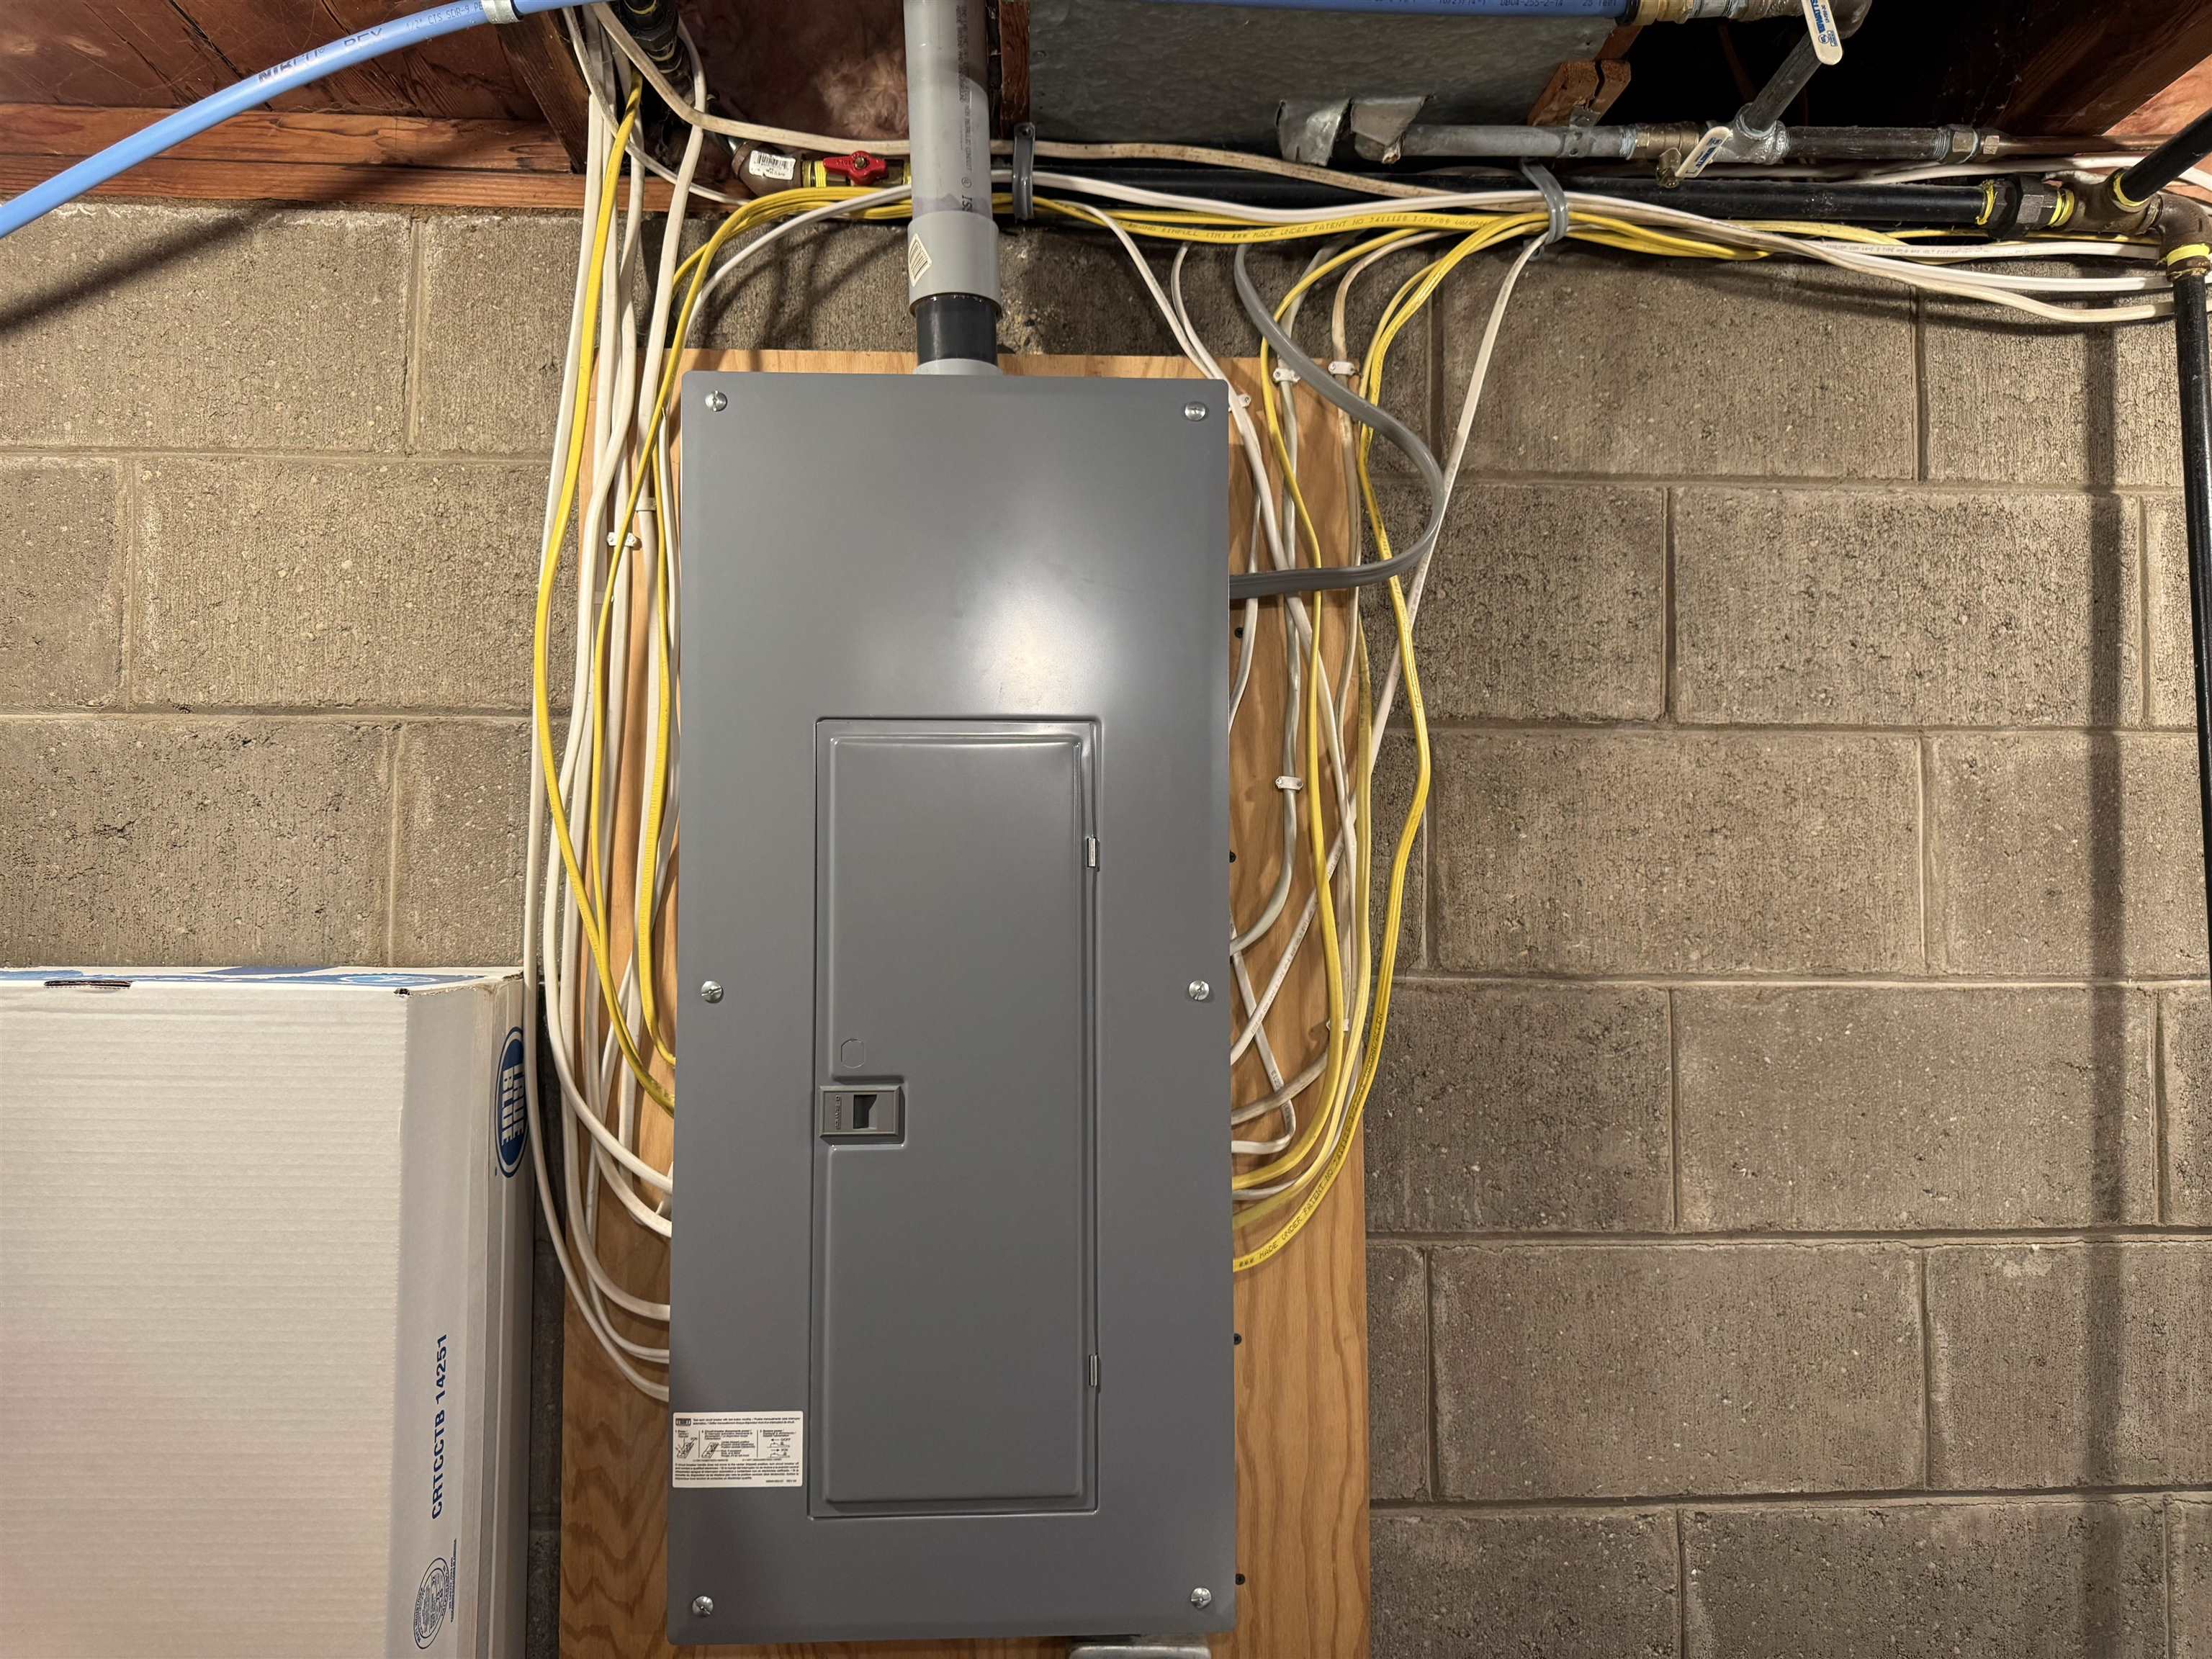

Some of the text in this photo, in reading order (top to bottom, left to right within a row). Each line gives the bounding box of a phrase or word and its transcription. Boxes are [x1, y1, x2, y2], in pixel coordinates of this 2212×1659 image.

[502, 1067, 514, 1146] BLUE
[1303, 1183, 1326, 1215] PATENT
[432, 1334, 447, 1519] CRTCCTB 14251
